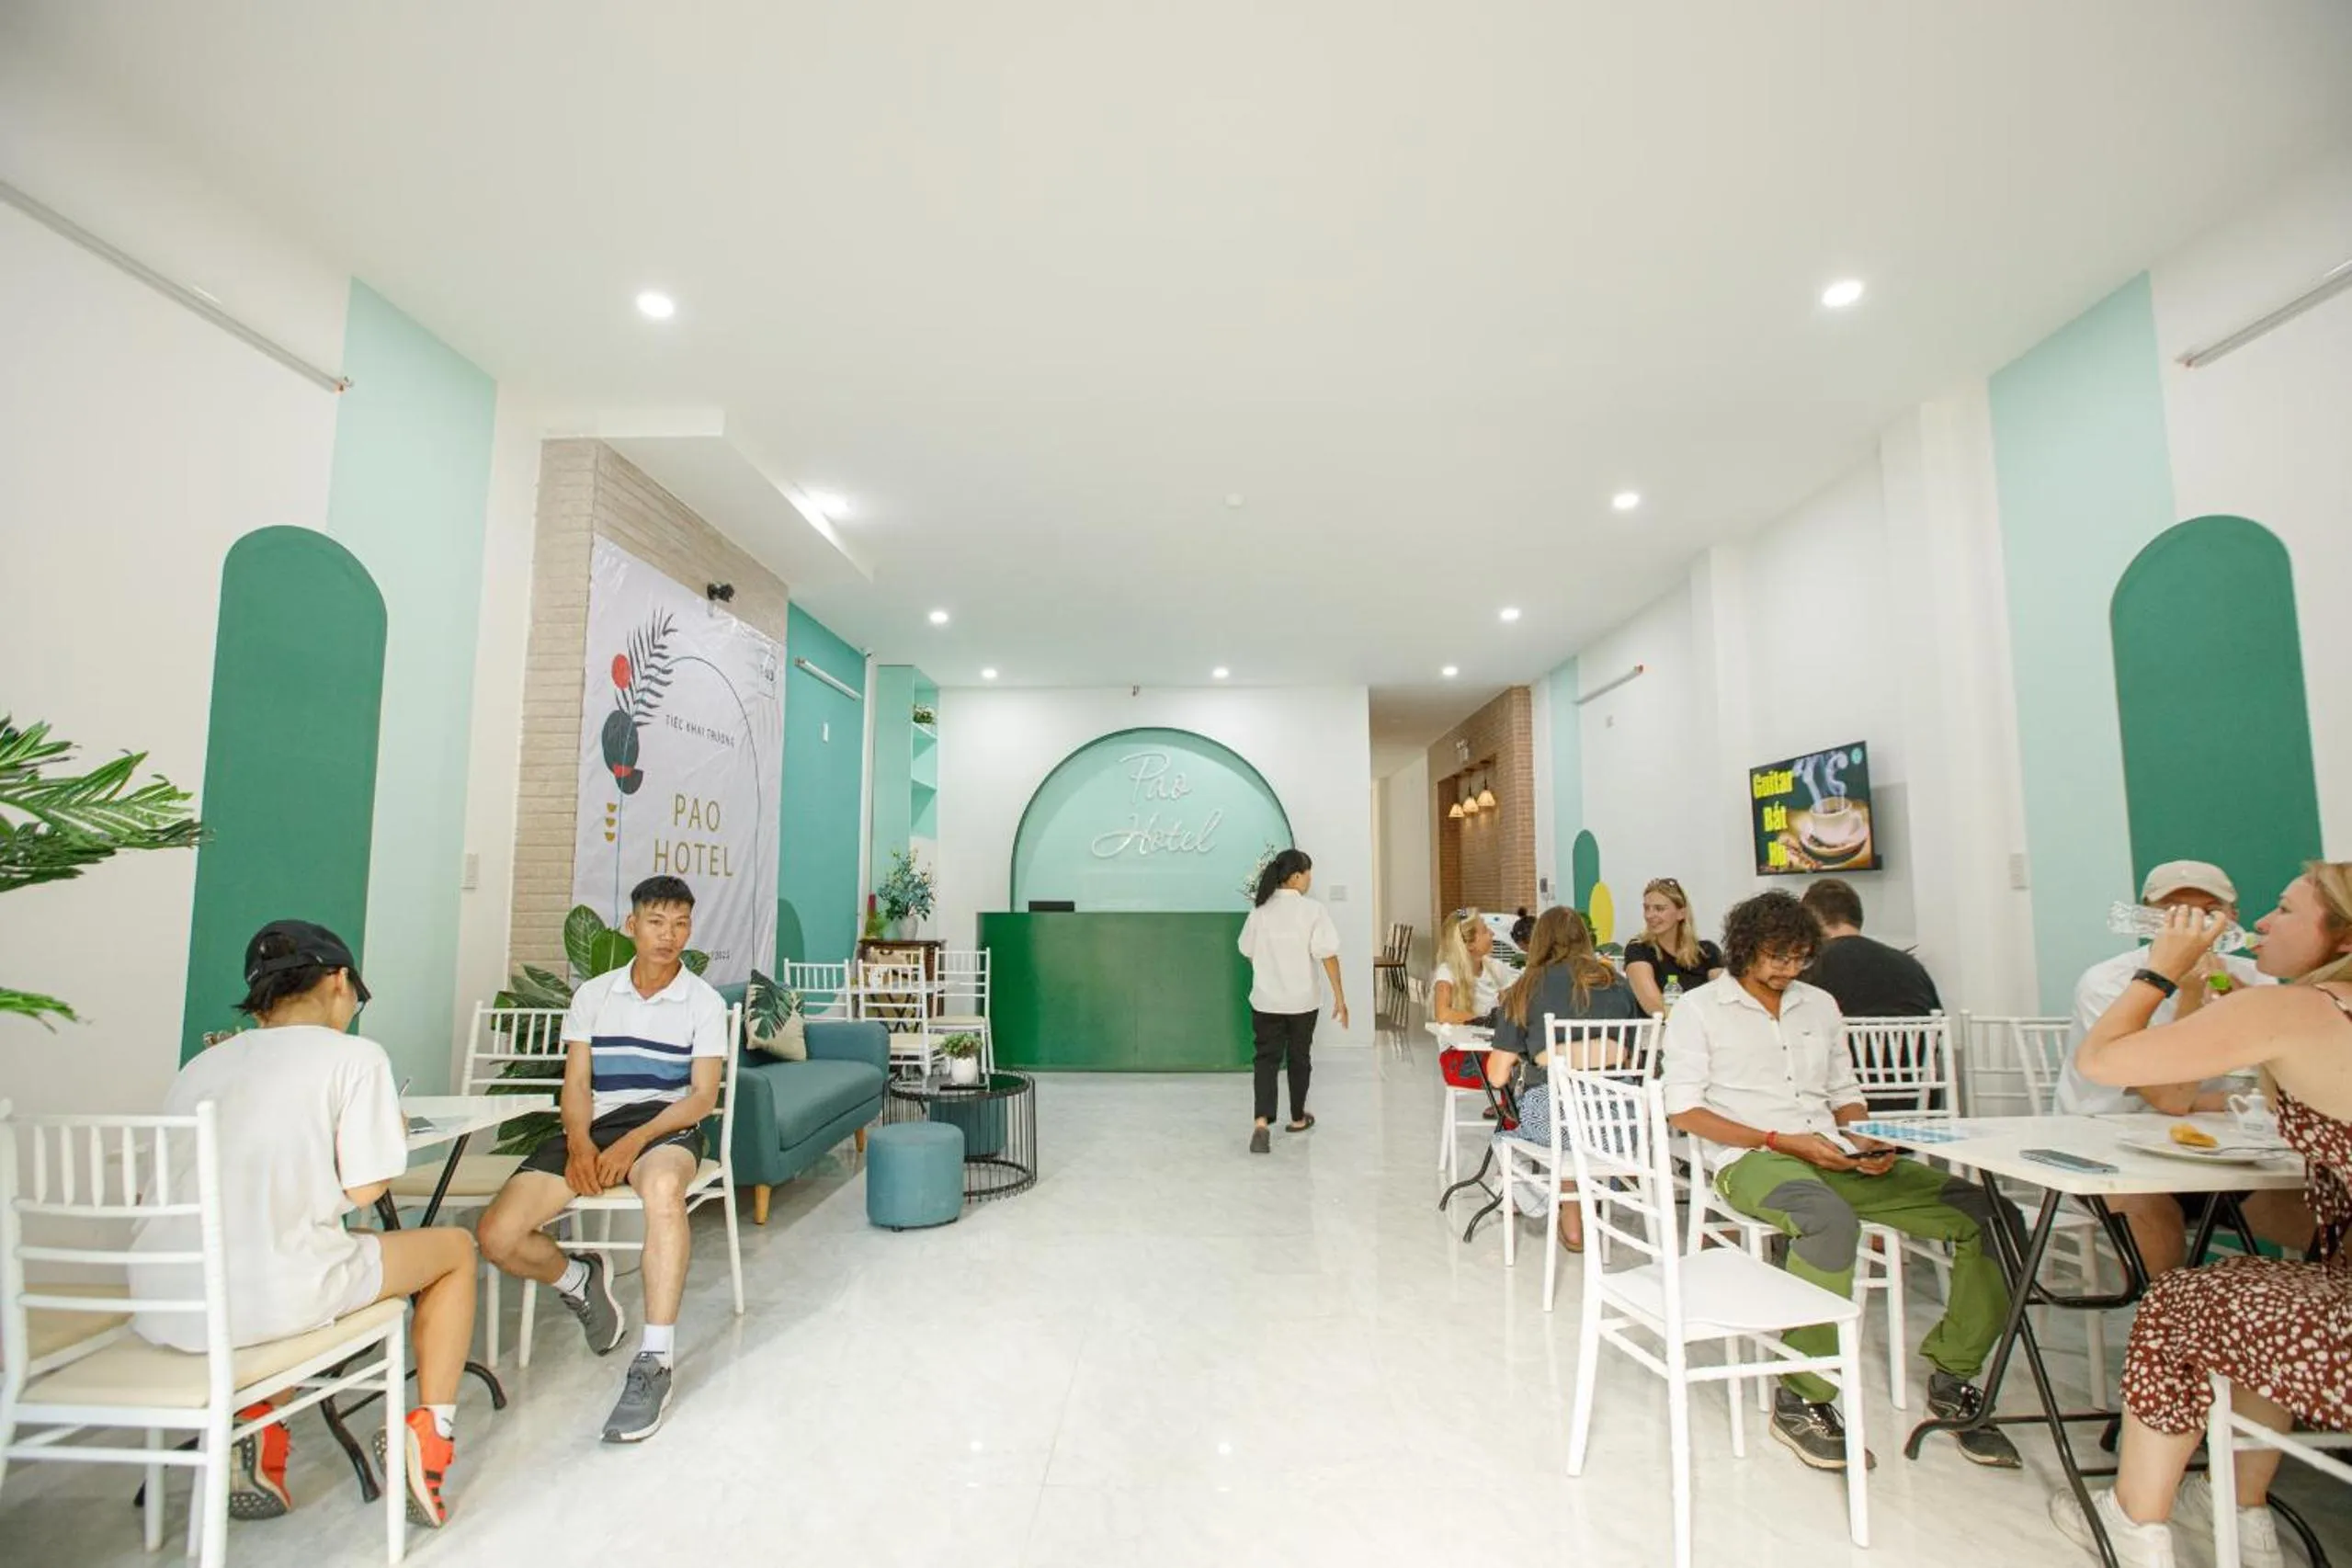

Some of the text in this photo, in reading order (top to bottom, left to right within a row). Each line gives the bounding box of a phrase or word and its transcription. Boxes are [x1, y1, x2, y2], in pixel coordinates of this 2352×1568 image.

[1118, 750, 1192, 805] Pao
[1753, 769, 1793, 799] Guitar
[674, 793, 721, 832] PAO
[1091, 808, 1223, 859] Hotel
[653, 838, 733, 877] HOTEL
